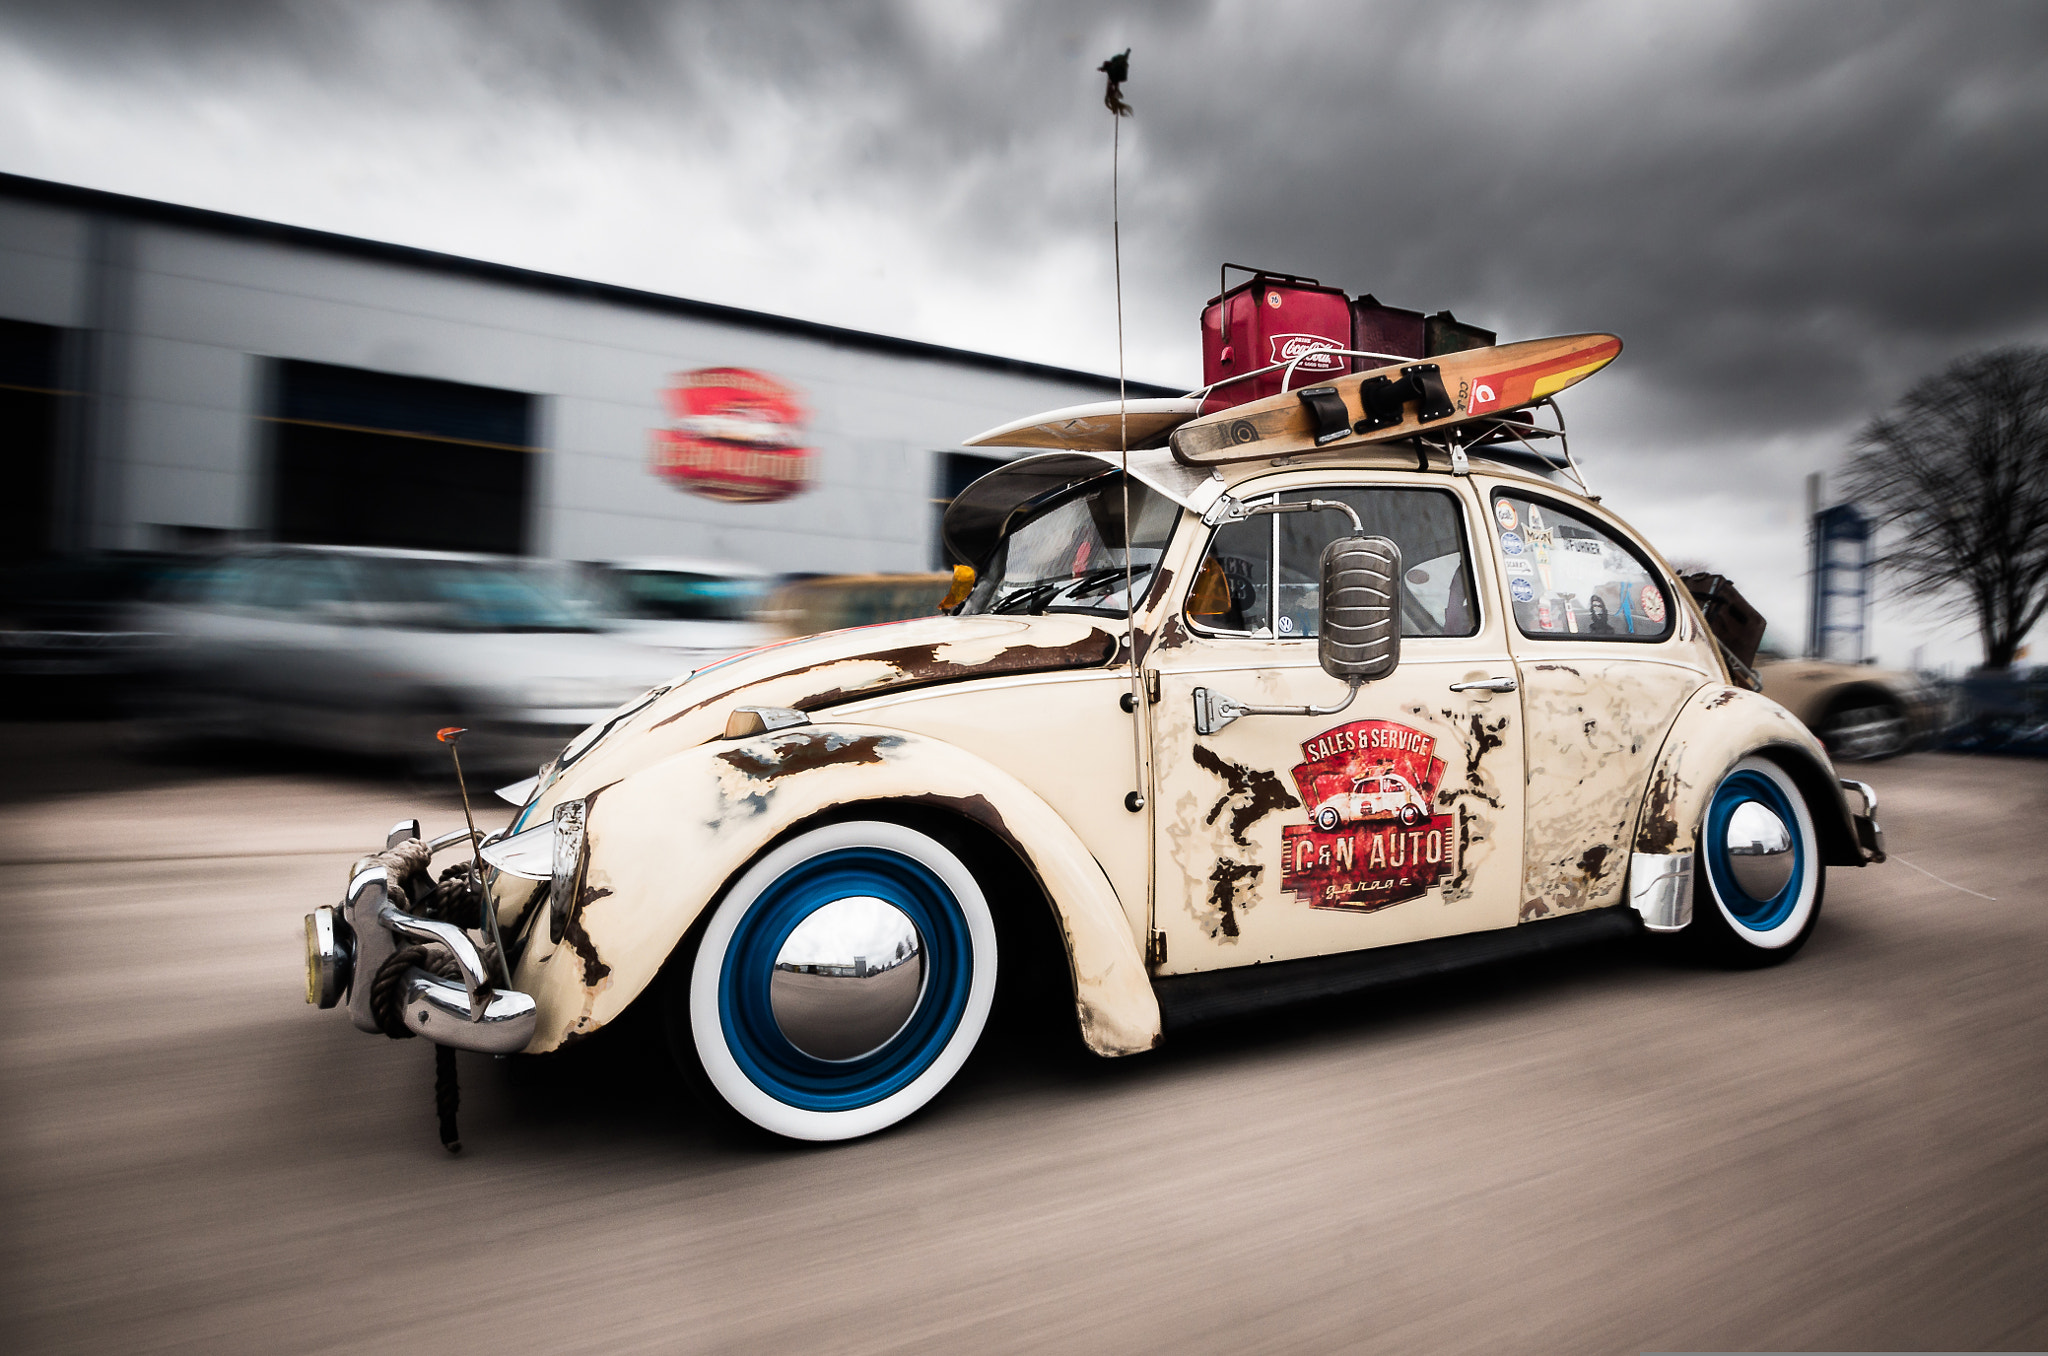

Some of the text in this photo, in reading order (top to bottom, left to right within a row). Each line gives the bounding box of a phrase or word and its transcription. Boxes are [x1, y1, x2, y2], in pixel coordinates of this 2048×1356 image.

[1526, 529, 1552, 545] MOON
[1307, 728, 1431, 762] SALES & SERVICE
[1369, 830, 1442, 869] AUTO
